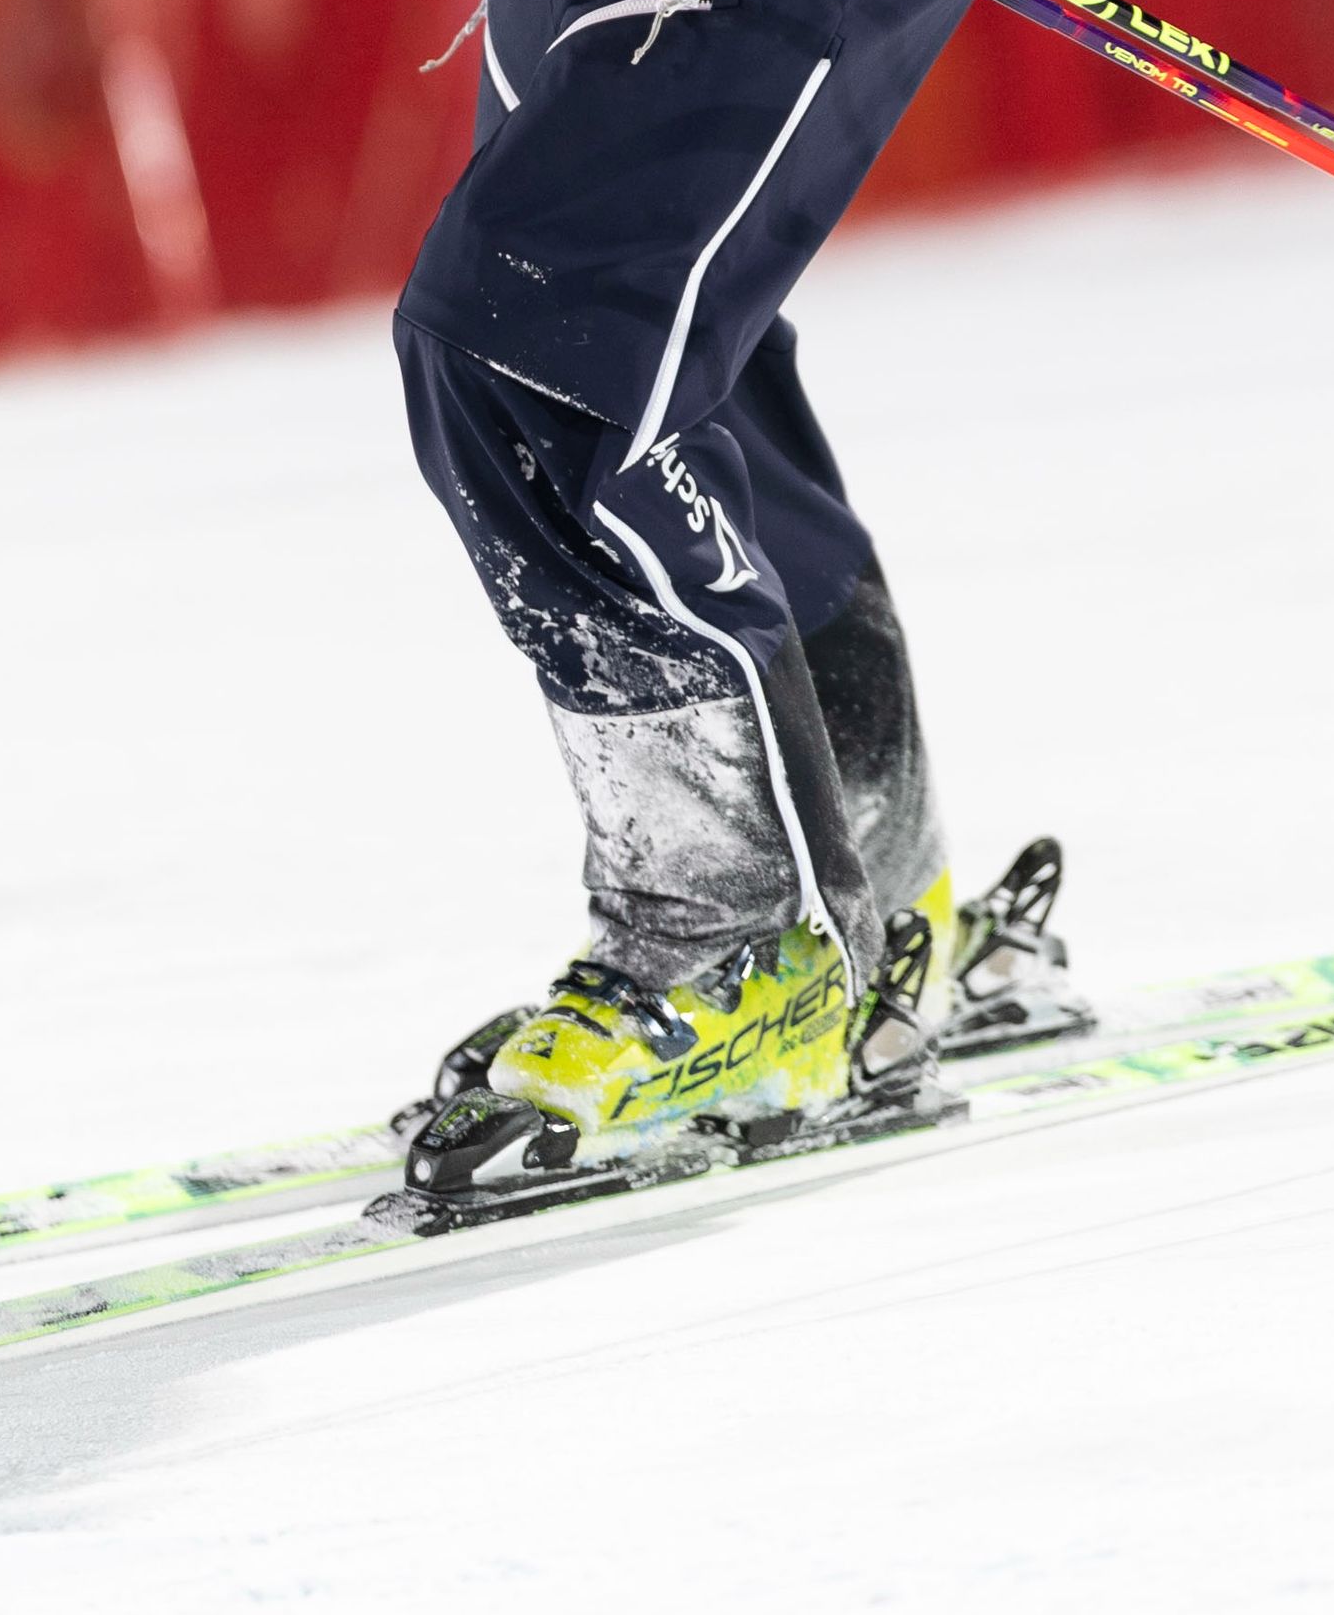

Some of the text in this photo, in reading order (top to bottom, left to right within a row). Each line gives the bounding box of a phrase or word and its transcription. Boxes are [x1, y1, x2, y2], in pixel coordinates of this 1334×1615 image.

[1104, 42, 1198, 98] VENOM TR
[1130, 5, 1231, 75] LEKI
[610, 960, 844, 1120] FISCHER
